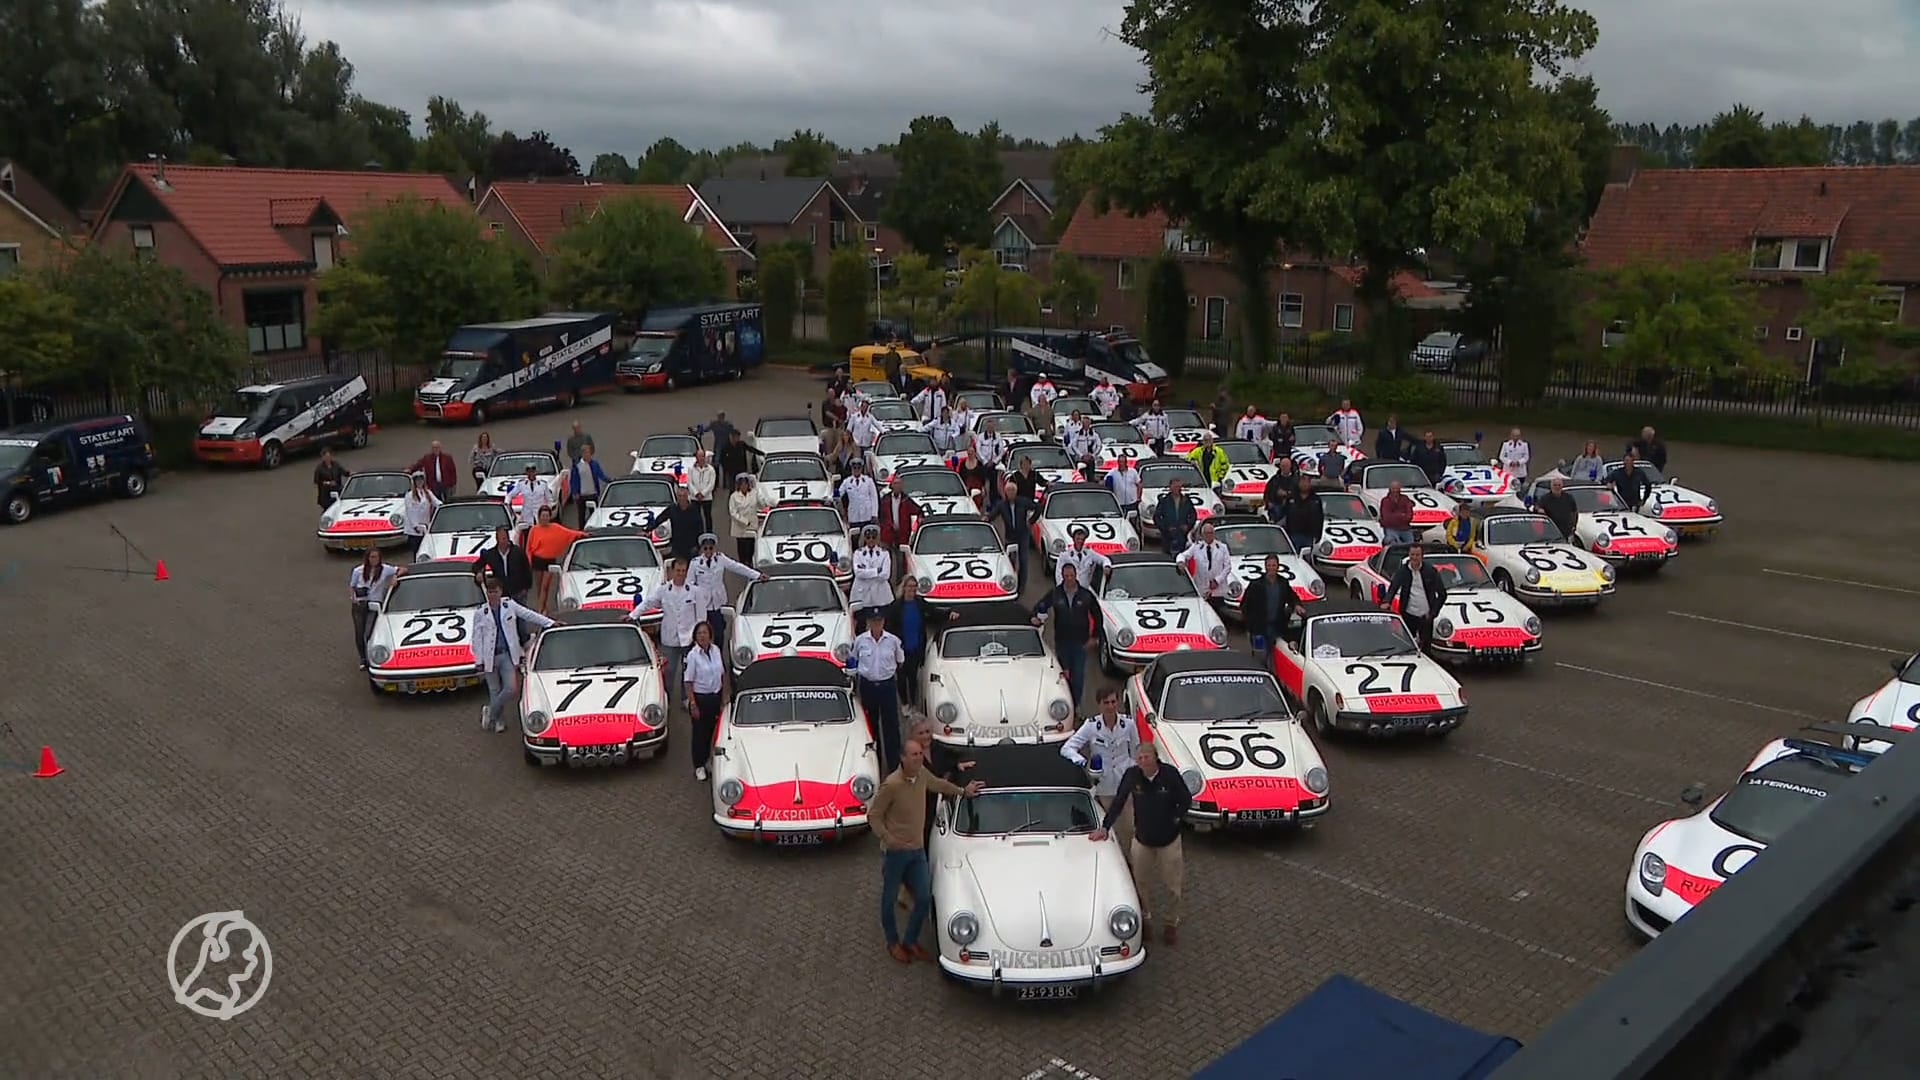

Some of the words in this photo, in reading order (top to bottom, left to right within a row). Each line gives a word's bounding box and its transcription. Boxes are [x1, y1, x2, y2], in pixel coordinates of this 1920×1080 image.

[700, 311, 732, 325] STATE
[741, 308, 760, 319] ART
[551, 346, 572, 362] STATE
[579, 336, 593, 349] ART
[79, 431, 110, 445] STATE
[117, 427, 135, 437] ART
[1105, 447, 1138, 458] 10
[1232, 468, 1269, 481] 19
[772, 485, 812, 499] 14
[342, 503, 394, 517] 44
[606, 510, 653, 528] 93
[1325, 526, 1379, 544] 99
[1595, 517, 1648, 537] 24
[450, 534, 492, 555] 17
[776, 541, 833, 563] 50
[1519, 548, 1588, 571] 63
[936, 559, 993, 581] 26
[585, 576, 643, 598] 28
[1135, 608, 1191, 630] 87
[1444, 601, 1505, 624] 75
[400, 615, 467, 647] 23
[761, 623, 827, 649] 52
[1180, 678, 1192, 686] 24
[1193, 676, 1221, 684] ZHOU
[1222, 676, 1264, 684] GUANYU
[1345, 662, 1417, 695] 27
[555, 676, 639, 713] 77
[751, 695, 763, 703] 22
[764, 692, 788, 701] YUKI
[791, 691, 838, 700] TSUNODA
[557, 713, 634, 727] RIJKSPOLITIE
[1199, 732, 1287, 771] 66
[1211, 778, 1296, 791] RIJKSPOLITIE
[1762, 778, 1828, 798] FERNANDO
